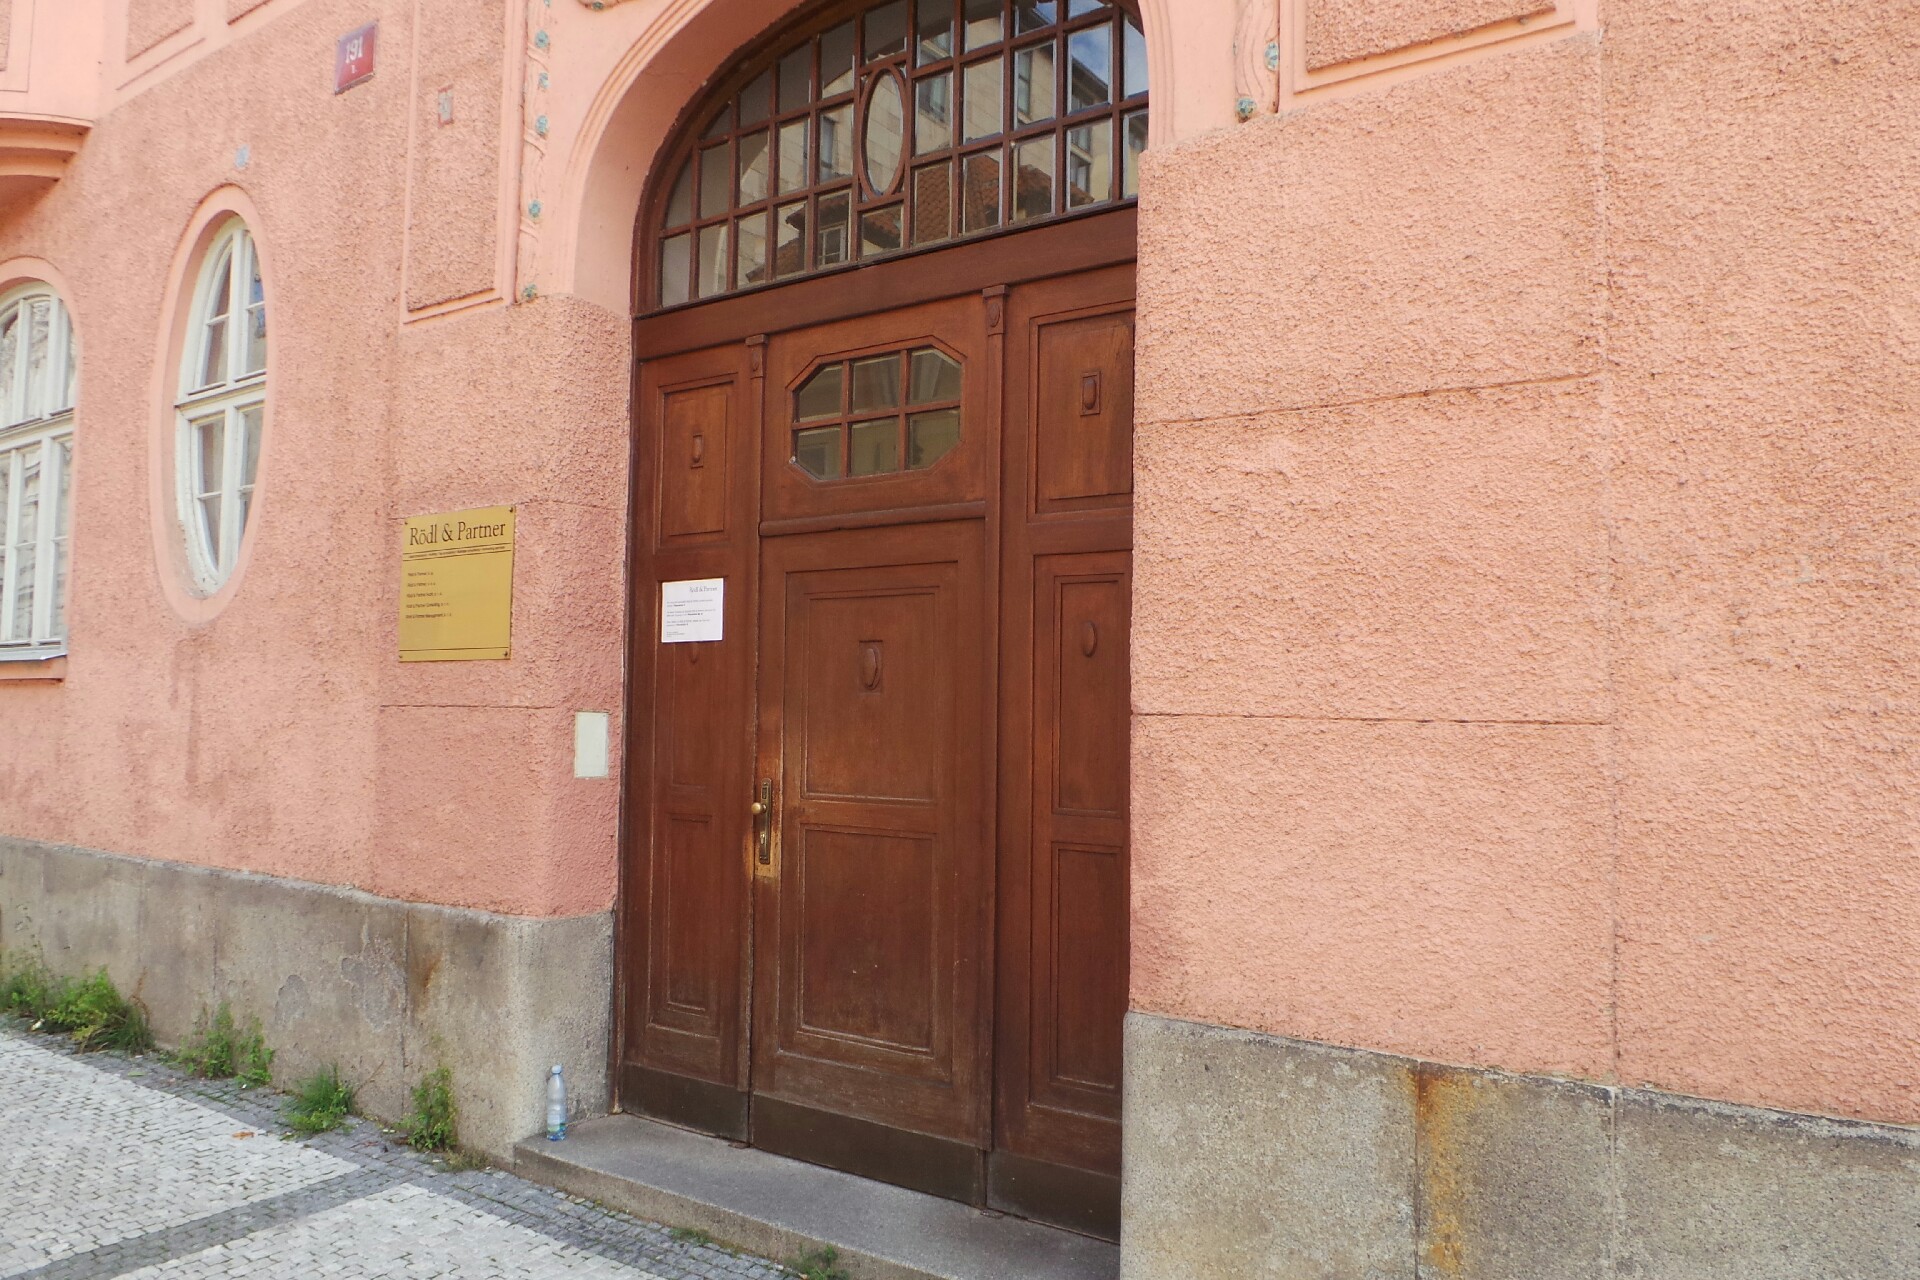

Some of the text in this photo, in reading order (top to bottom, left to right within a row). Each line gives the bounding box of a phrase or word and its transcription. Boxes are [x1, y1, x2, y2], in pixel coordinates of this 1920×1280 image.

[345, 36, 364, 64] 191
[409, 521, 506, 546] Rödl & Partner
